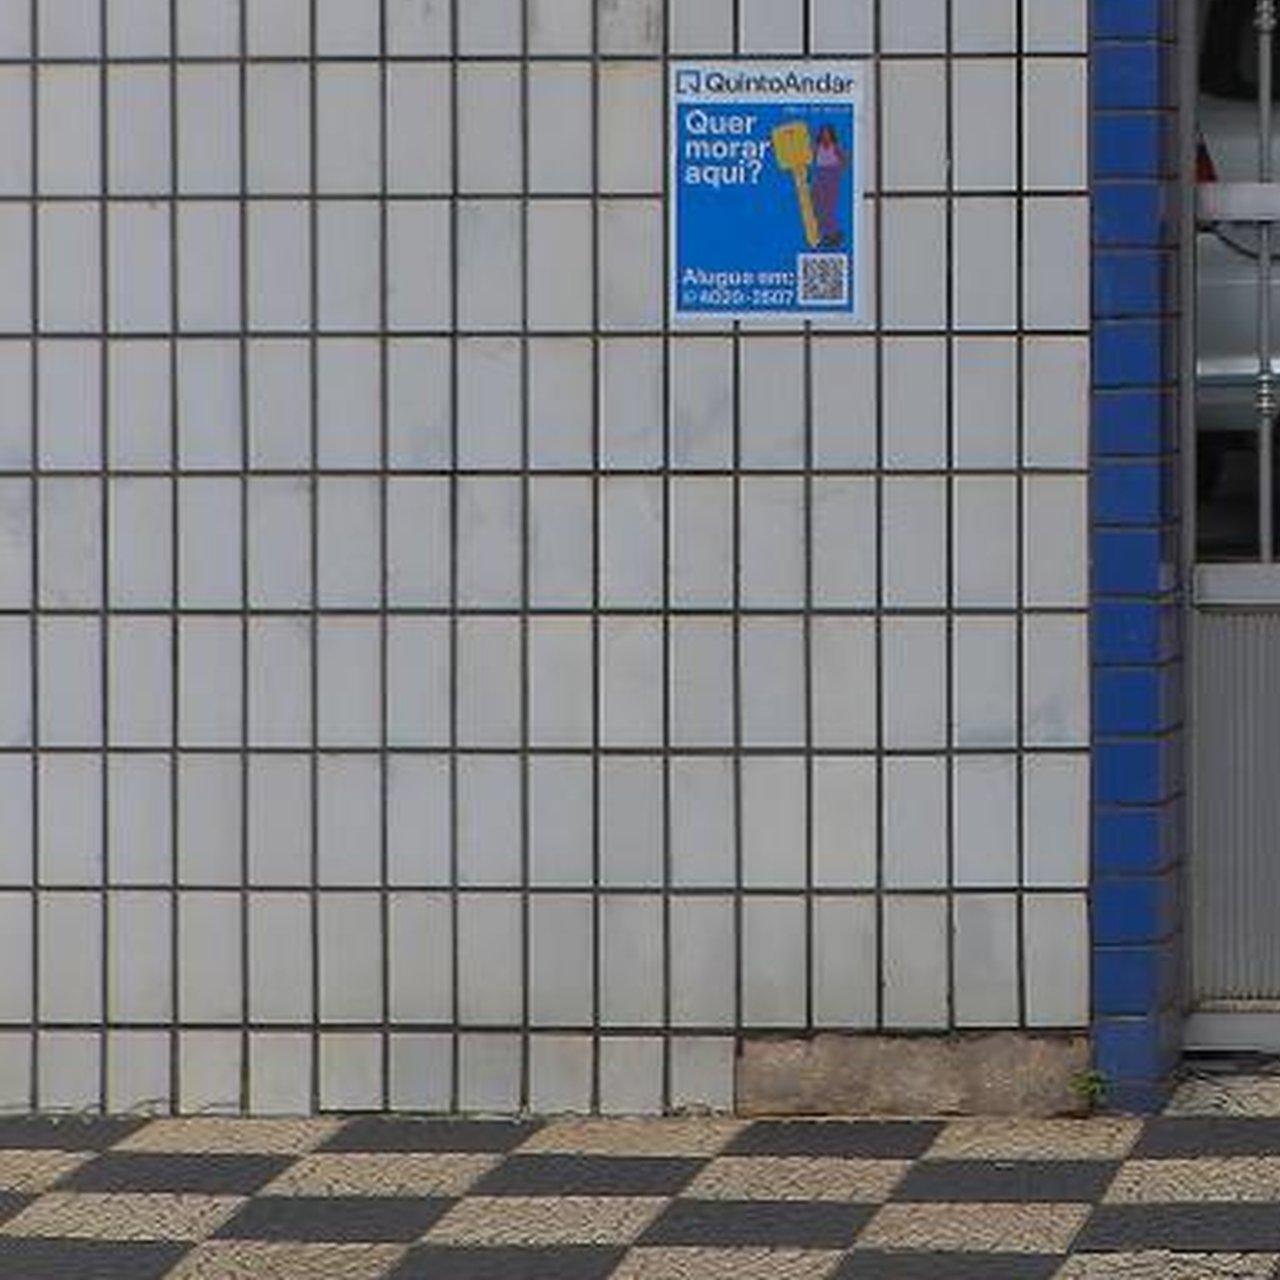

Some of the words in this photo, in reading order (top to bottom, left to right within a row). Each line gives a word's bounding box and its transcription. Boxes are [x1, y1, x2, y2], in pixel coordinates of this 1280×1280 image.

[705, 70, 854, 95] QuintoAndar
[685, 109, 757, 135] Quer
[685, 138, 771, 160] morar
[685, 159, 762, 189] aqui?
